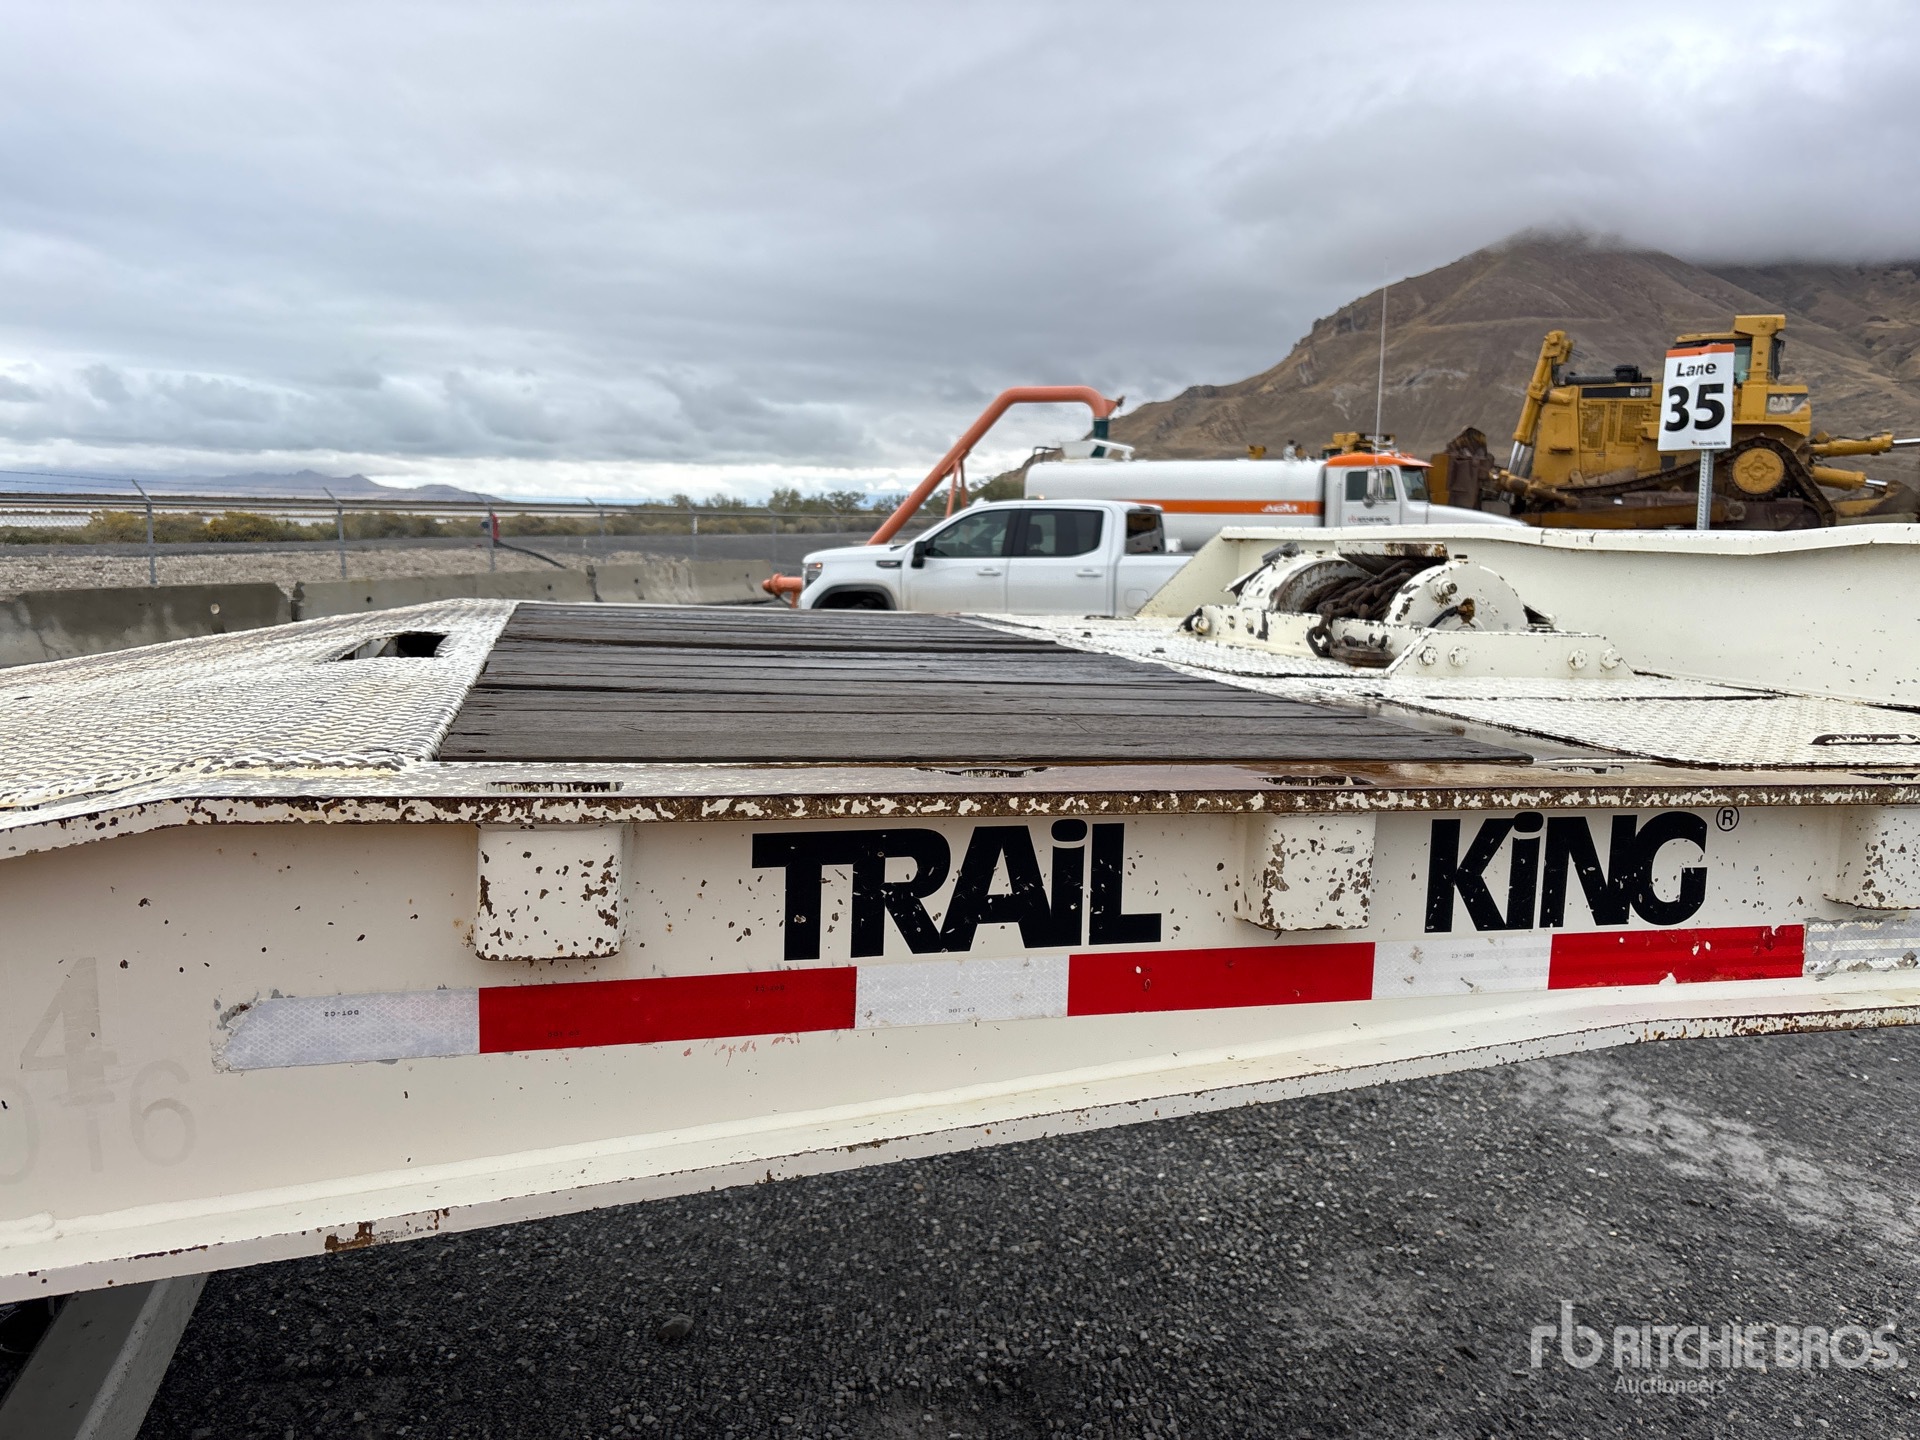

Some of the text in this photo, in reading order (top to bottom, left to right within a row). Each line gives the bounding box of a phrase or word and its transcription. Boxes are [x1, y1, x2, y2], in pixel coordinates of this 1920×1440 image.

[1676, 362, 1717, 377] Lane
[1664, 383, 1725, 432] 35
[1768, 396, 1796, 412] CAT
[324, 1009, 360, 1018] DOT-C2
